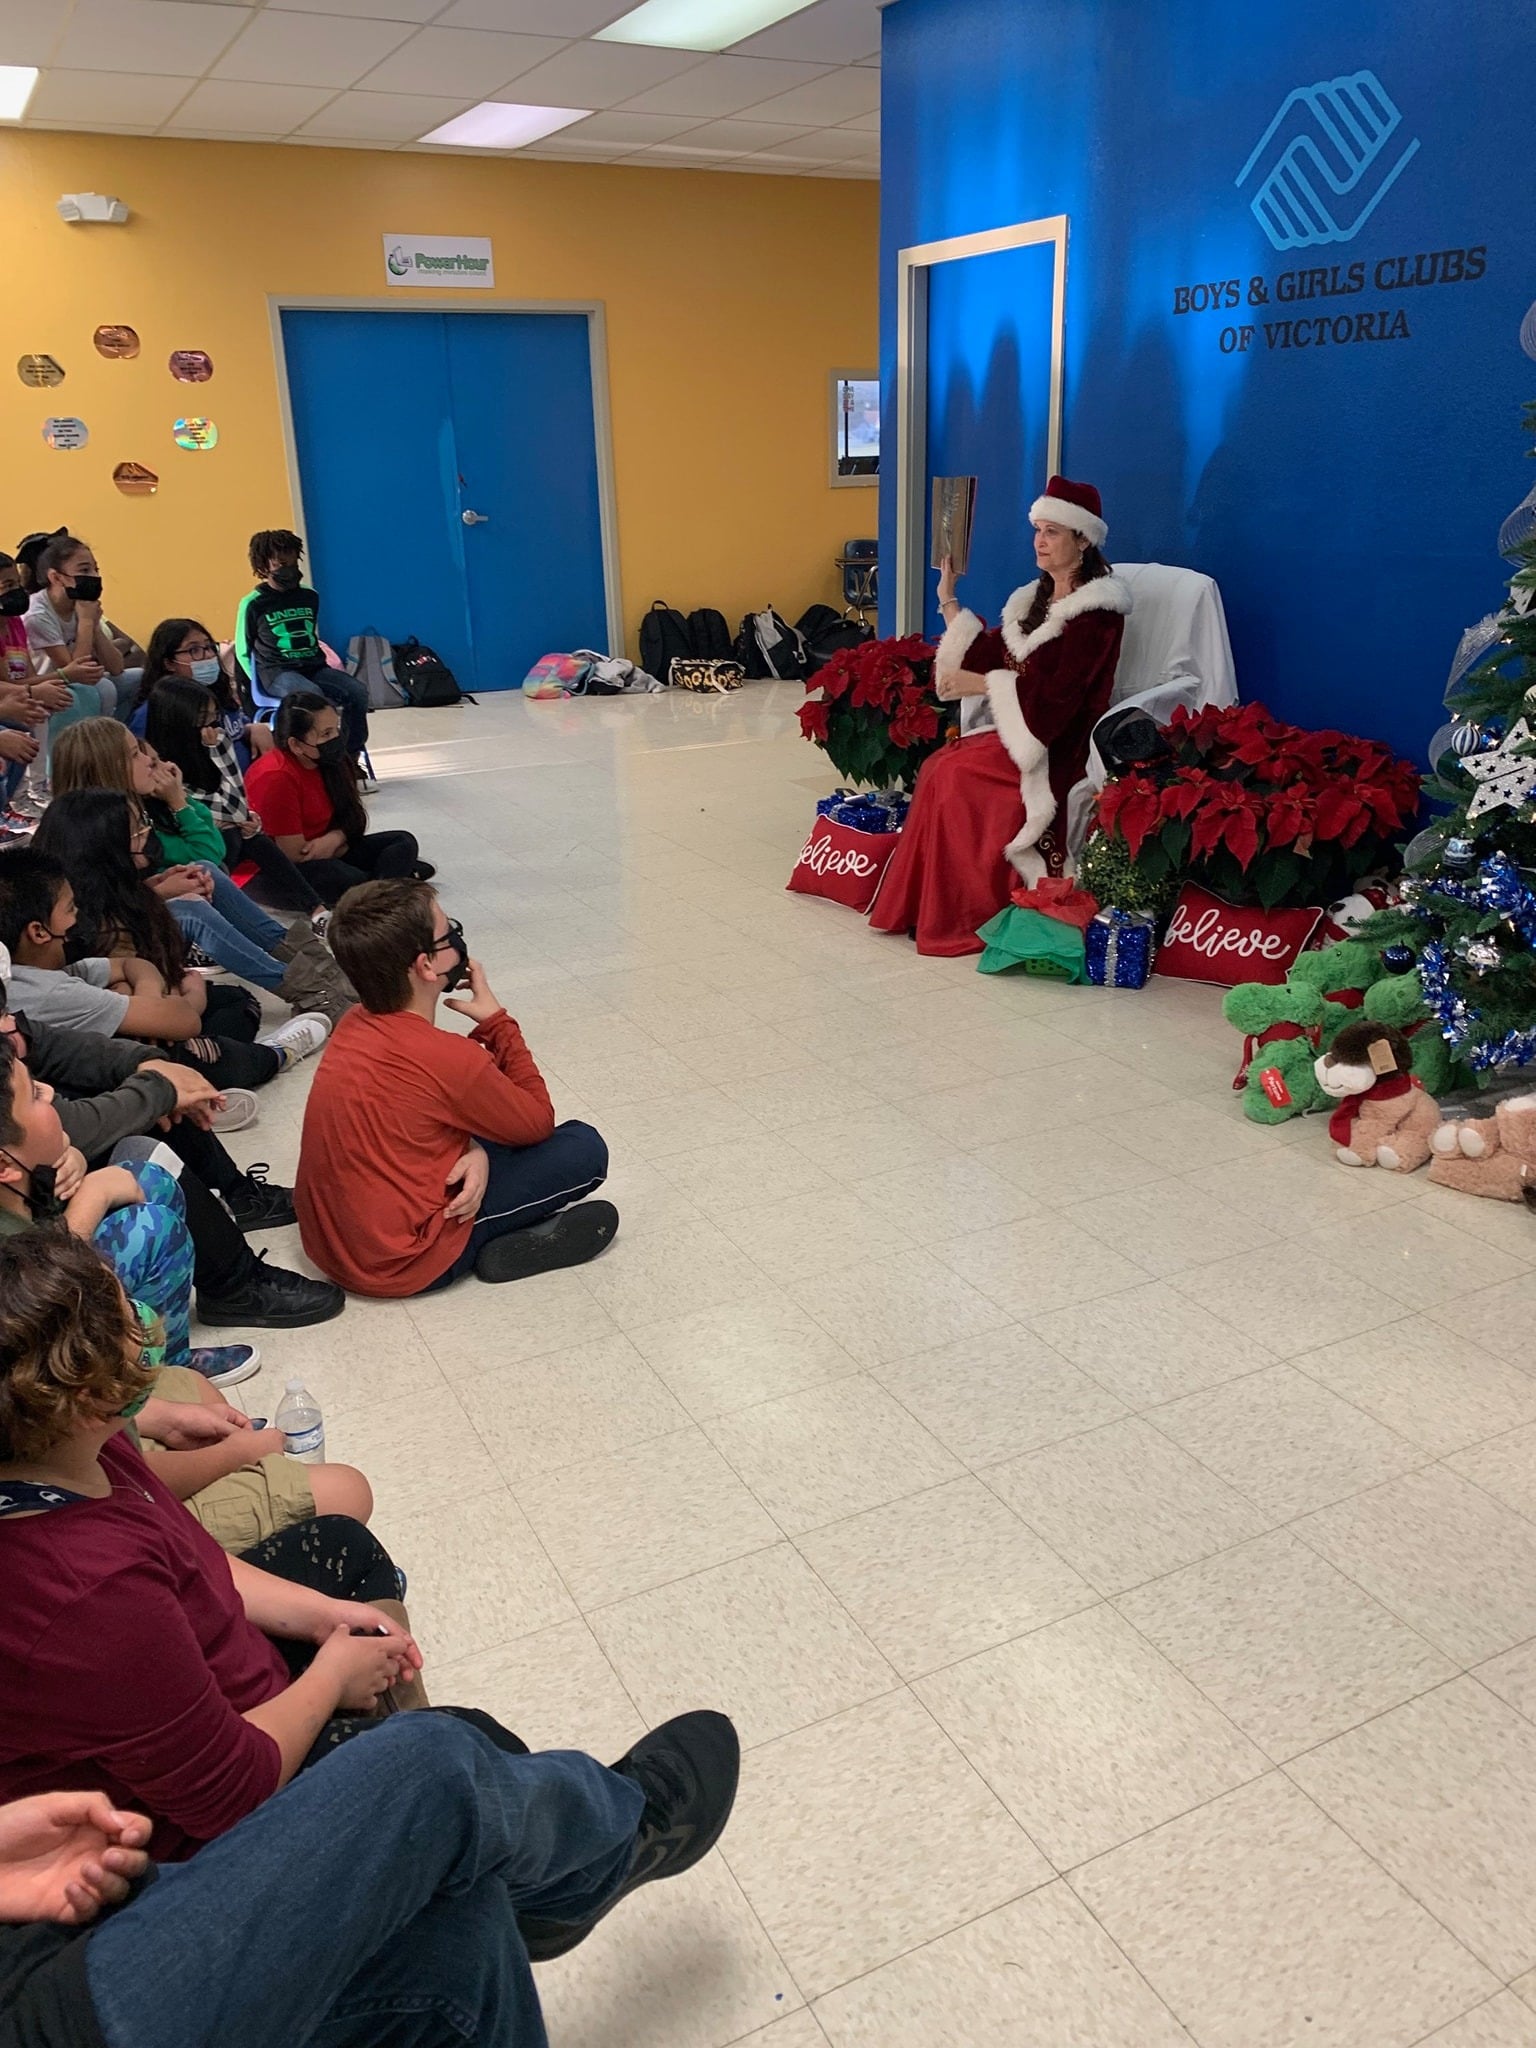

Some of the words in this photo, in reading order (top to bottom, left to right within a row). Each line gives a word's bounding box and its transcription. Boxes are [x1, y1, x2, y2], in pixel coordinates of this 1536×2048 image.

[1173, 279, 1240, 314] BOYS
[1247, 276, 1270, 306] &
[1275, 262, 1366, 302] GIRLS
[1374, 246, 1487, 291] CLUBS
[1219, 325, 1255, 354] OF
[1263, 309, 1411, 350] VICTORIA
[265, 607, 313, 622] UNDER
[1163, 904, 1291, 960] believe
